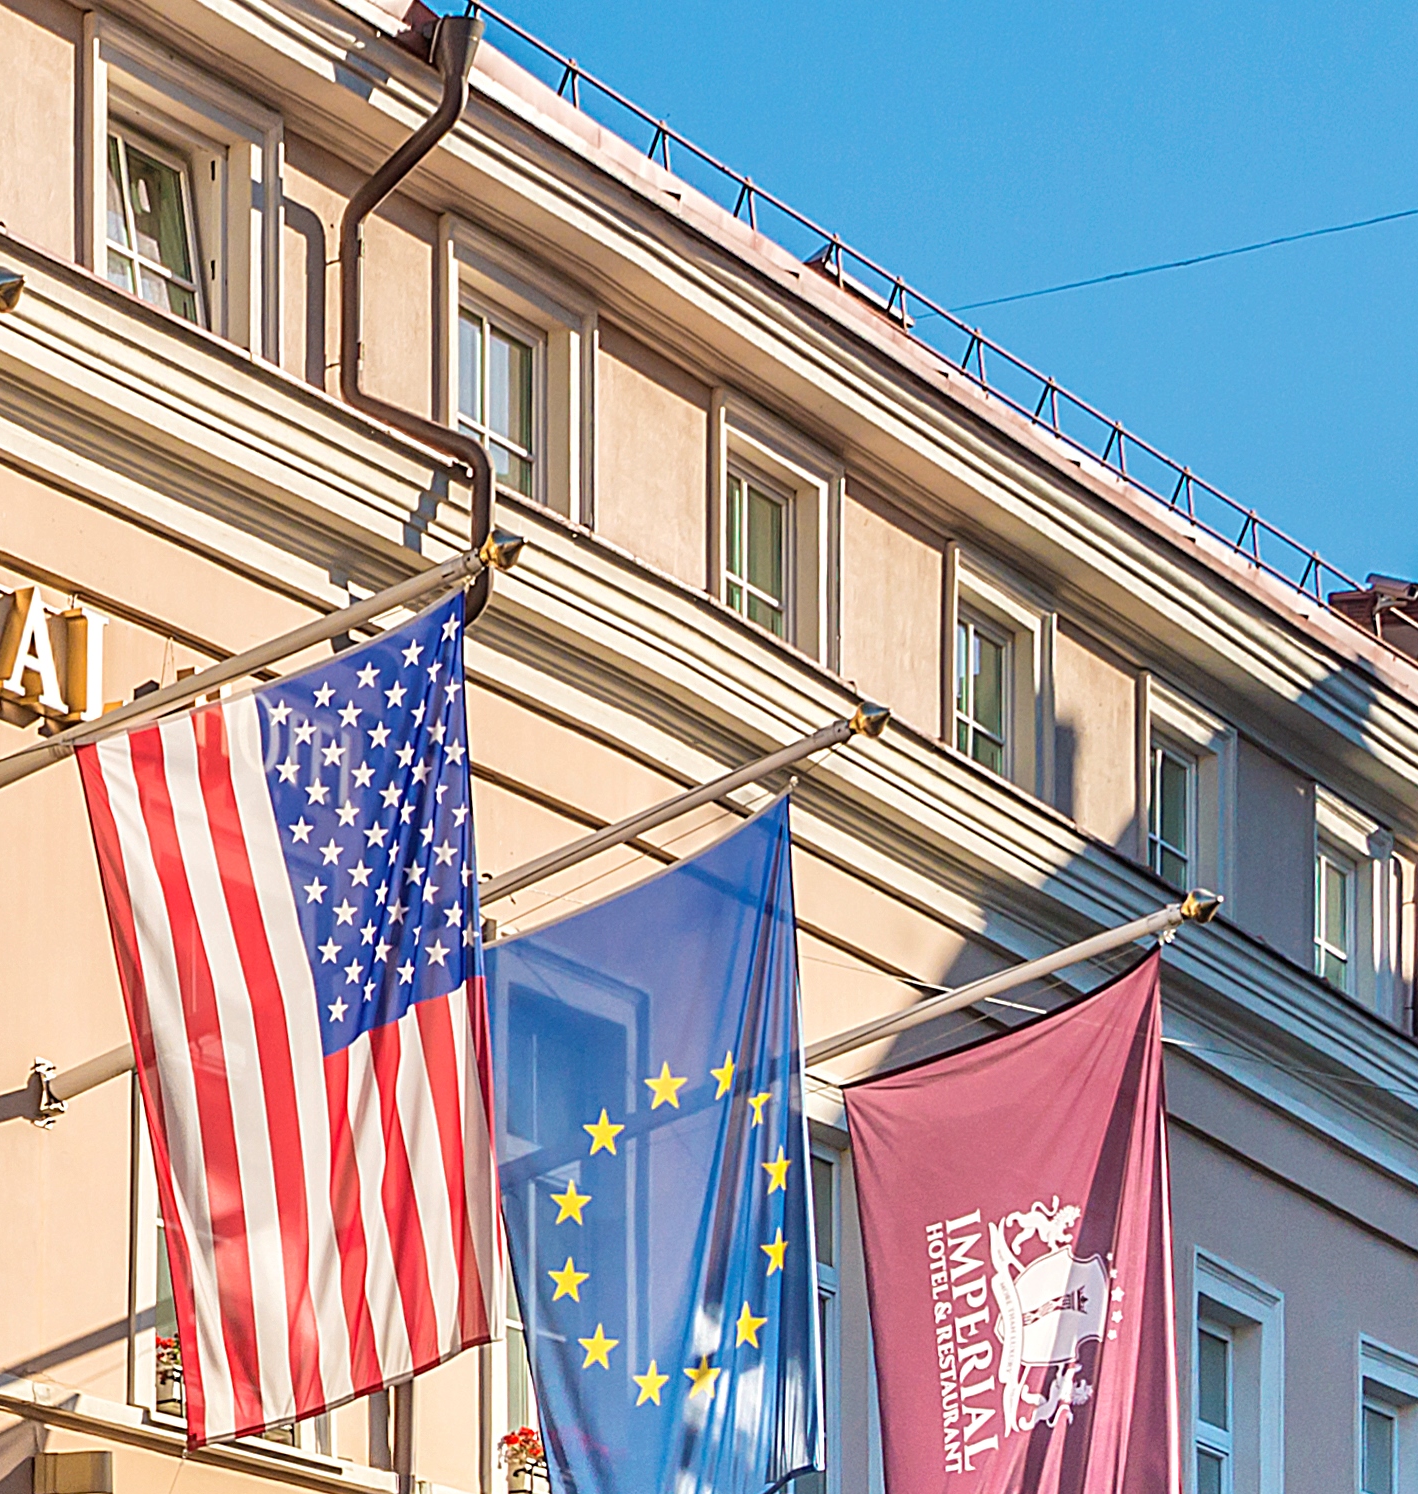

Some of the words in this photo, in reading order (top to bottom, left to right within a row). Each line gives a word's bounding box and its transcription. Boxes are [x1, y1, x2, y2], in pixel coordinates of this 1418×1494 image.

[925, 1222, 950, 1299] HOTEL
[933, 1301, 953, 1318] &
[944, 1208, 1000, 1473] IMPERIAL
[936, 1324, 963, 1474] RESTAURANT
